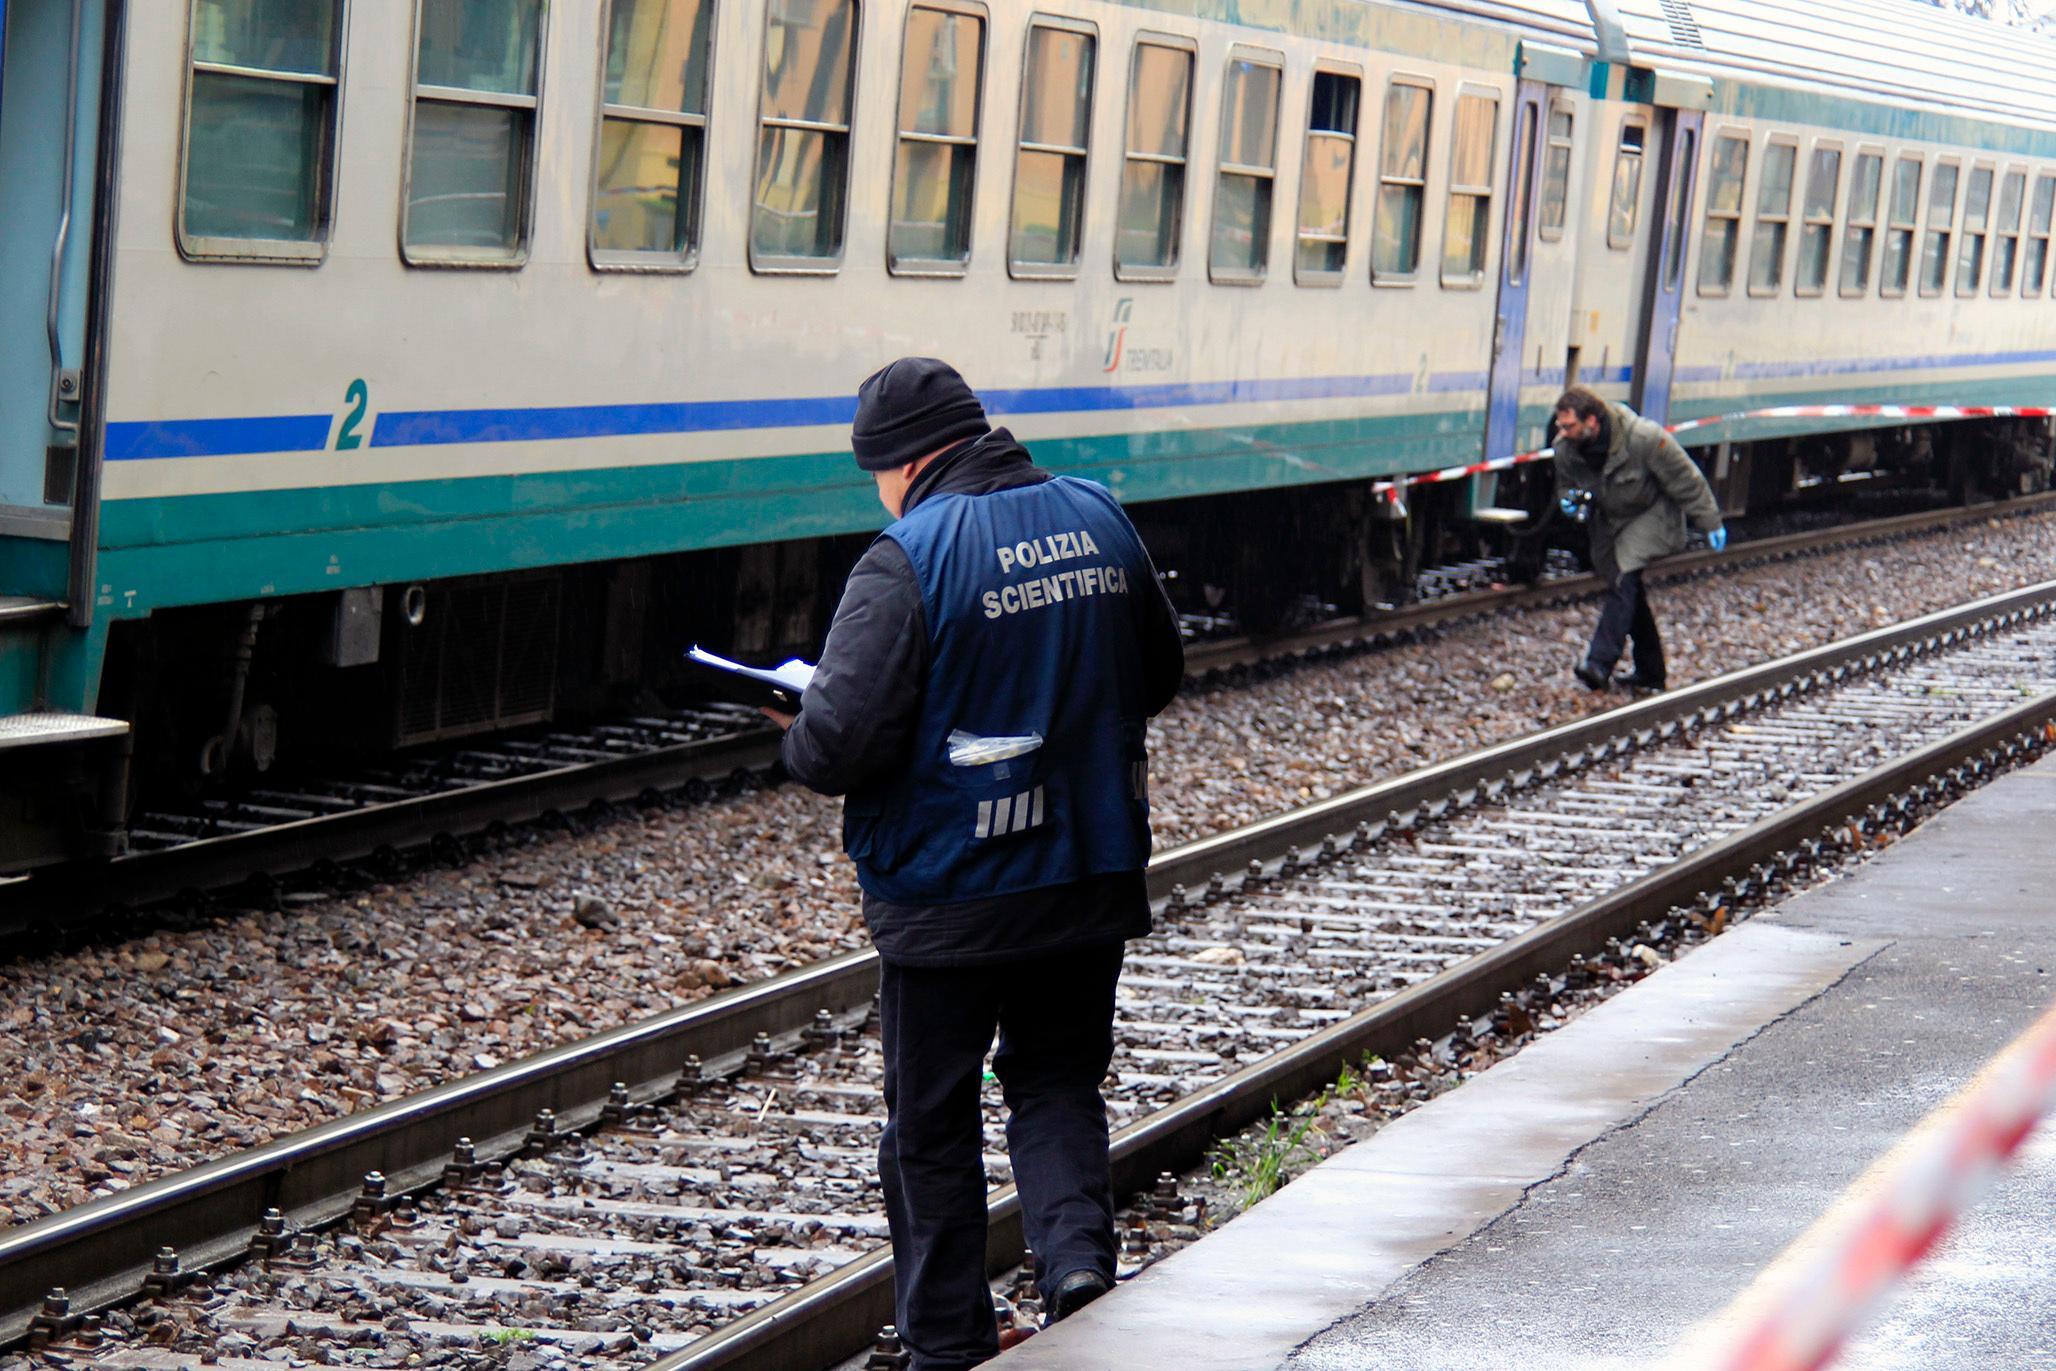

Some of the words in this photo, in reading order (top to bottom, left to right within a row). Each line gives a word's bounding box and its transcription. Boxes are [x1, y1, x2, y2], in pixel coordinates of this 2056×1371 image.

[335, 378, 368, 451] 2
[996, 530, 1100, 574] POLIZIA
[982, 566, 1128, 620] SCIENTIFICA
